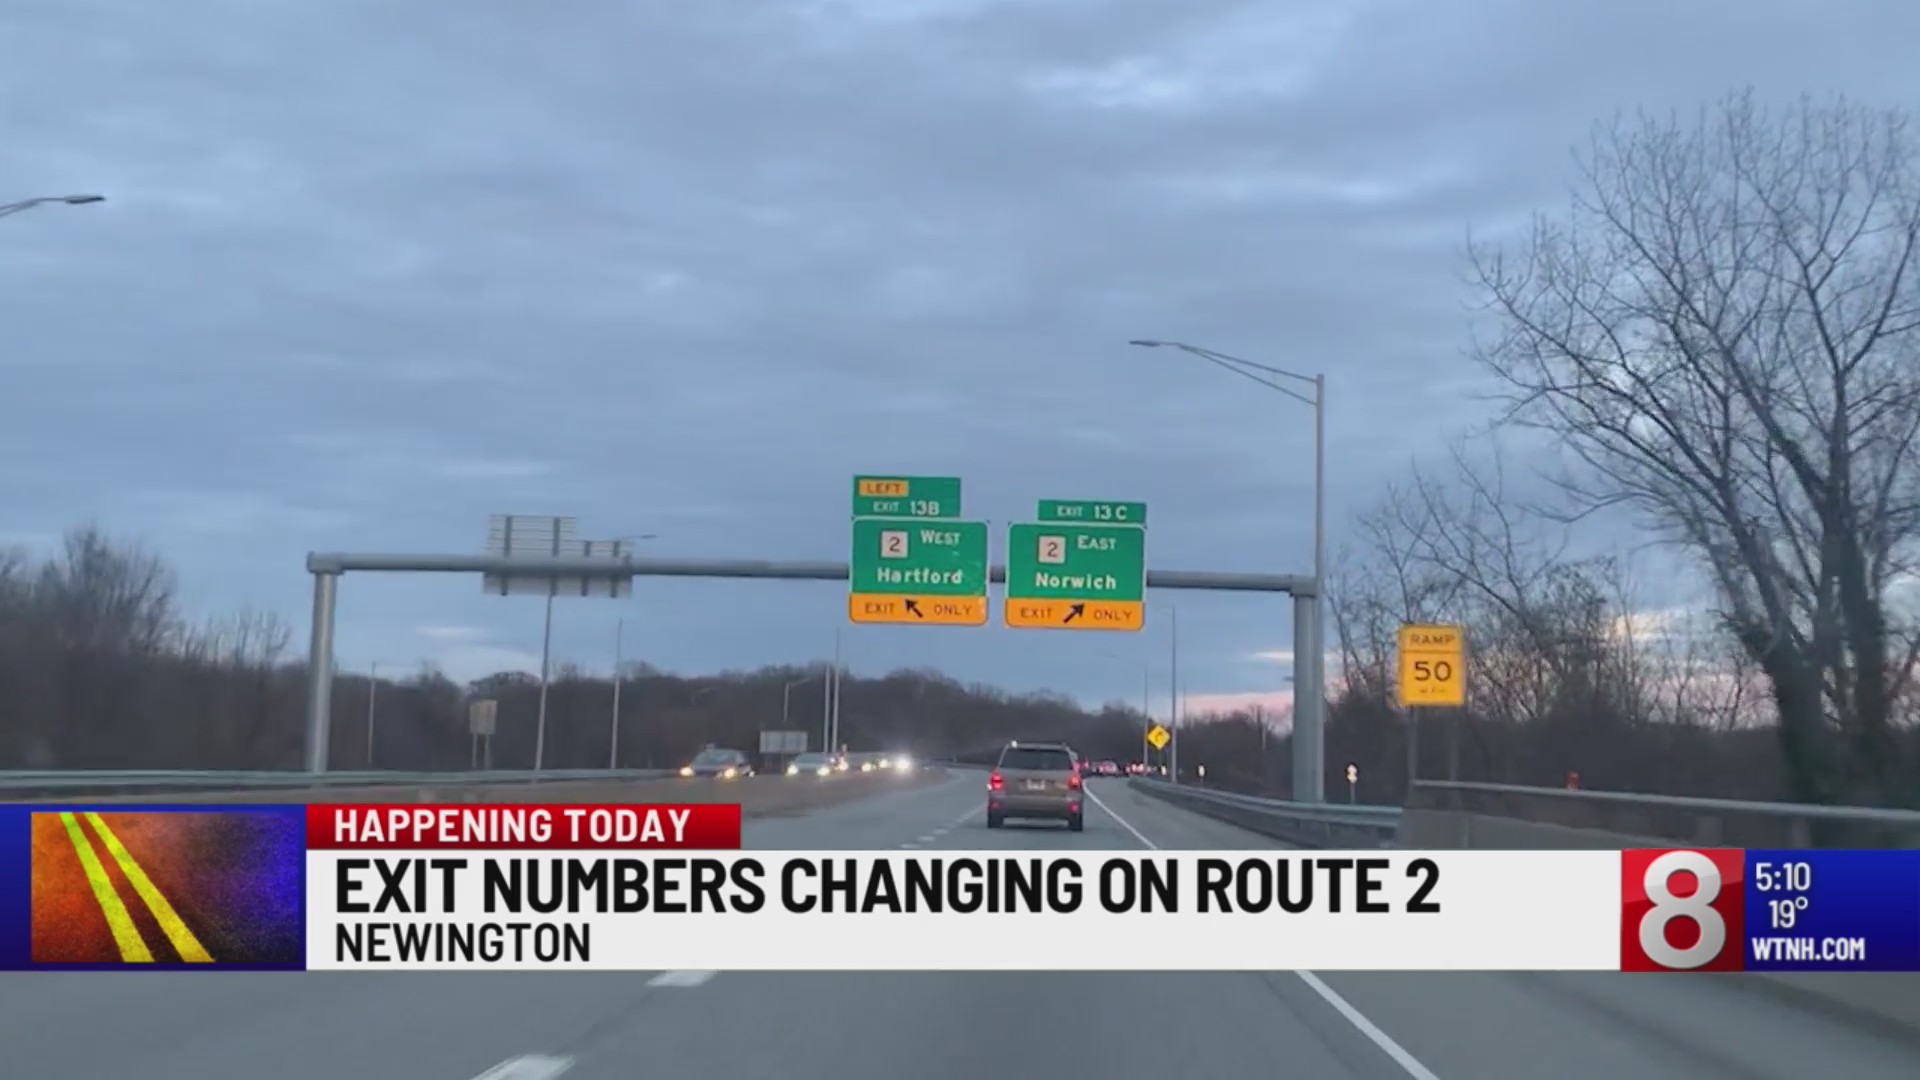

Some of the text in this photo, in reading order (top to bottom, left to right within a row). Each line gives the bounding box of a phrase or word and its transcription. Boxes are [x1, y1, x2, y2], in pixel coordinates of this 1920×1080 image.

[866, 482, 901, 494] LEFT
[873, 500, 940, 515] EXIT 13B
[1057, 505, 1083, 517] EXIT
[889, 536, 901, 553] 2
[1047, 535, 1117, 558] 2 EAST
[877, 567, 963, 584] Hartford
[1035, 572, 1117, 590] Norwich
[865, 602, 973, 616] EXIT ONLY
[1020, 608, 1132, 620] EXIT ONLY
[1414, 660, 1452, 682] 50
